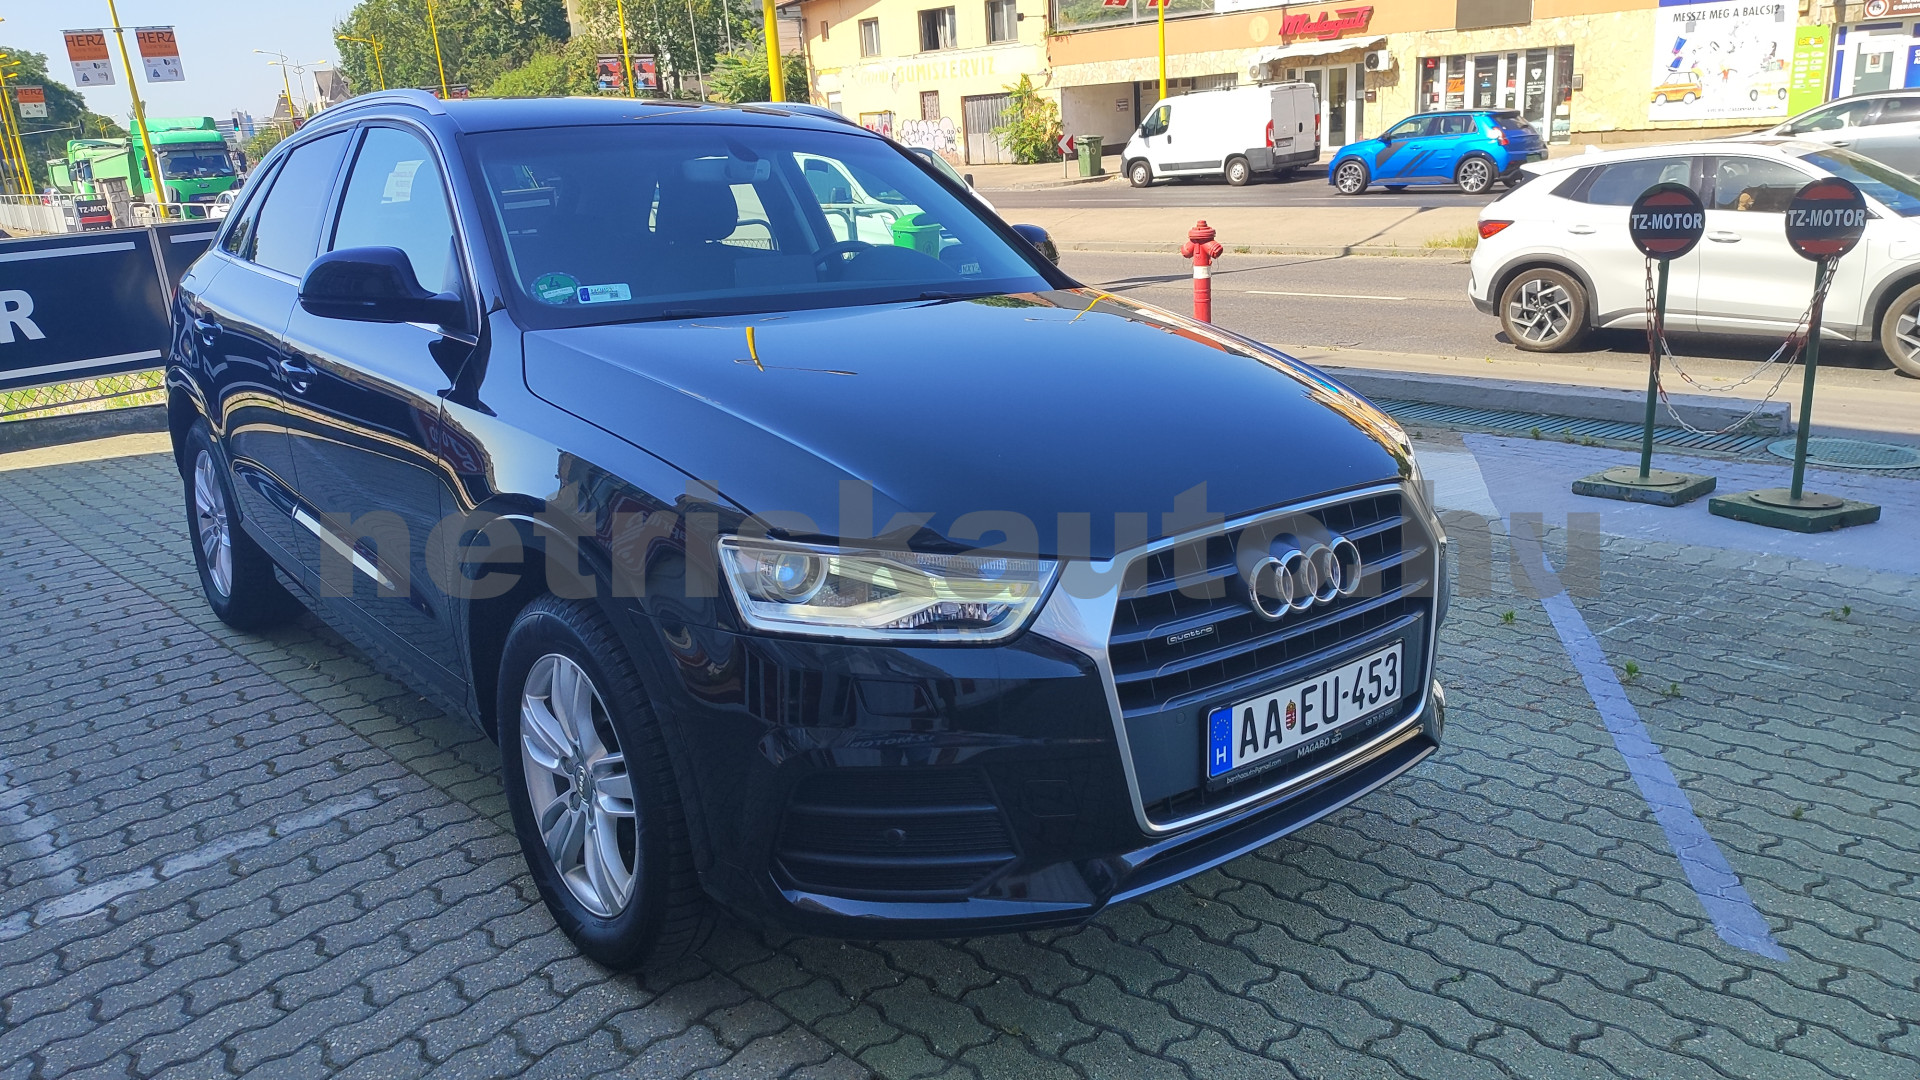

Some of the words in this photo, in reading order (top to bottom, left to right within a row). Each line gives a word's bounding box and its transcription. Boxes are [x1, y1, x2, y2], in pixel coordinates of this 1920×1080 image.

[1673, 10, 1706, 22] MESSZE
[1709, 9, 1730, 19] MEG
[1733, 8, 1740, 17] A
[1743, 4, 1780, 16] BALCSI?
[66, 33, 106, 47] HERZ
[138, 31, 175, 44] HERZ
[78, 205, 107, 213] TZ-MOT
[1788, 208, 1866, 227] TZ-MOTOR
[1632, 213, 1703, 230] TZ-MOTOR
[1169, 626, 1213, 643] quattro
[1216, 746, 1227, 765] H
